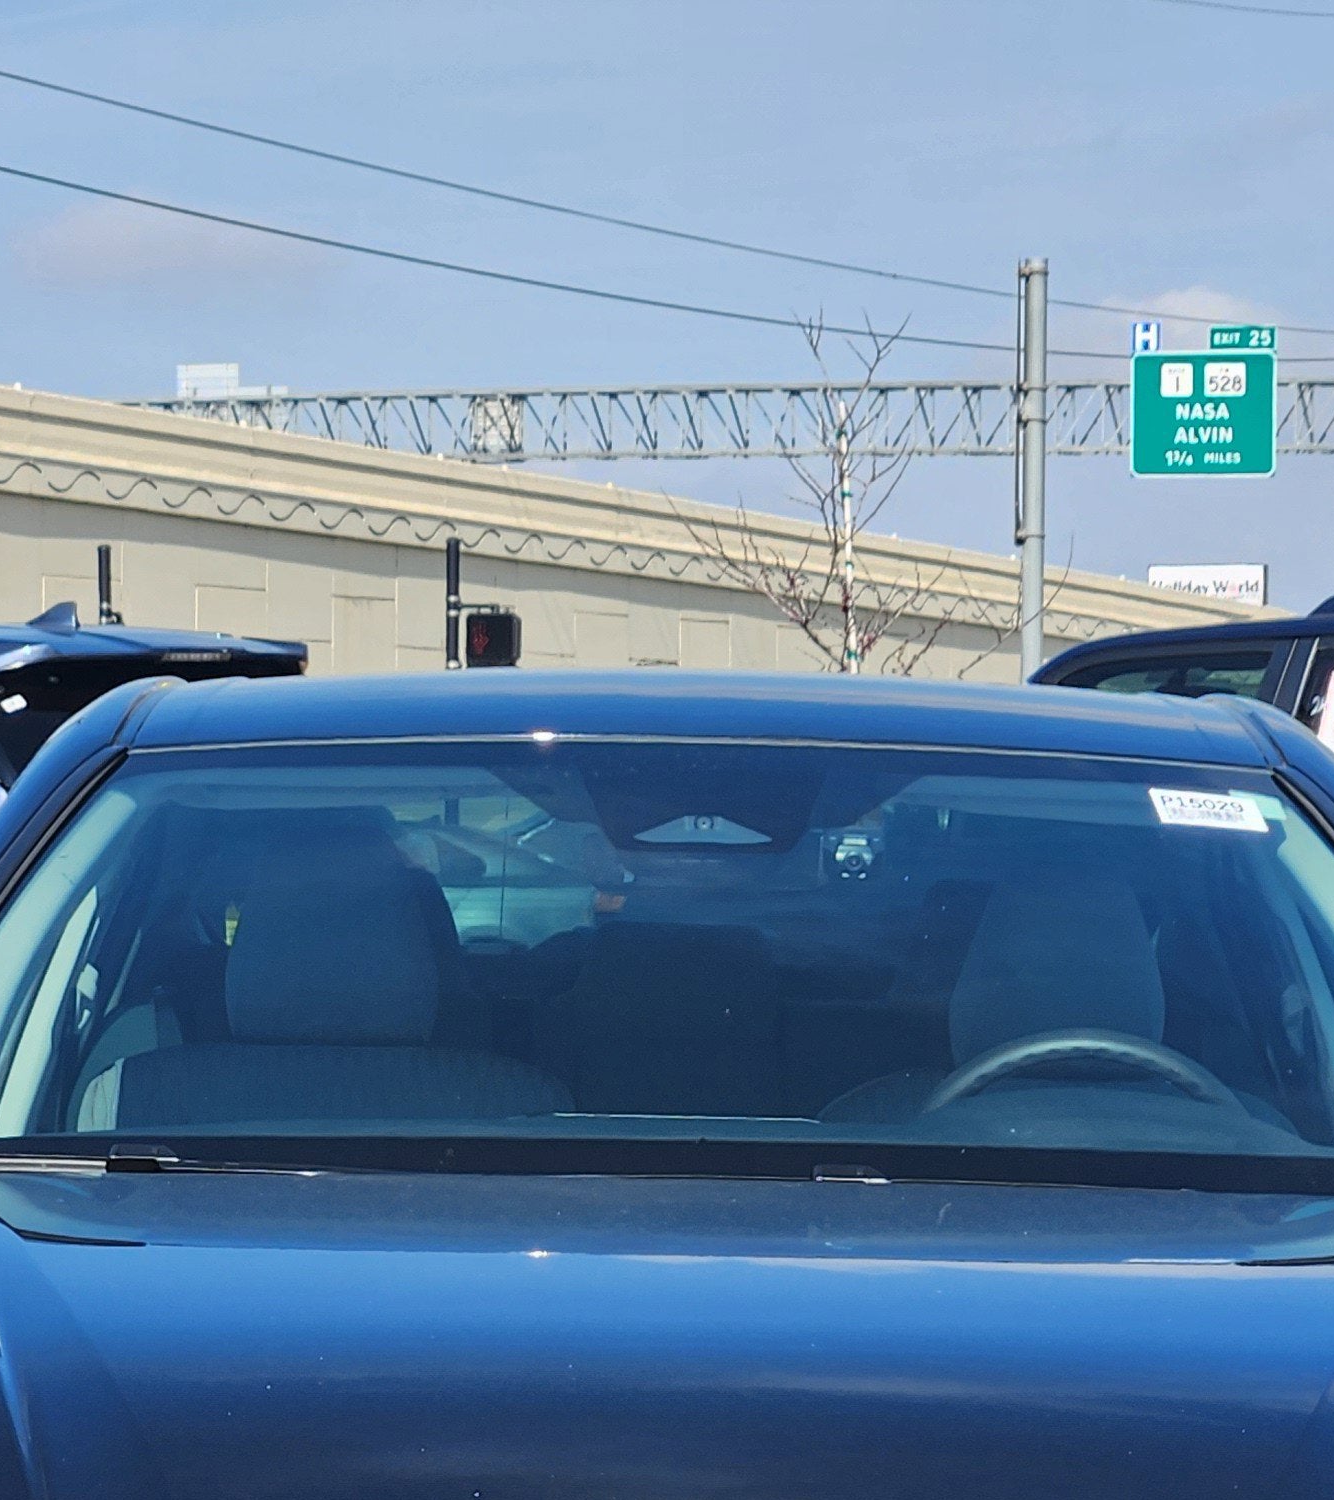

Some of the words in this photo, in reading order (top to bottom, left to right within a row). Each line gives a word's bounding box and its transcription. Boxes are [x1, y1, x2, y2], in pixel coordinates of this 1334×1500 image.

[1213, 332, 1241, 345] EXIT
[1249, 329, 1272, 346] 25
[1208, 375, 1243, 393] 528
[1175, 402, 1230, 421] NASA
[1173, 426, 1234, 445] ALVIN
[1203, 451, 1242, 464] MILES
